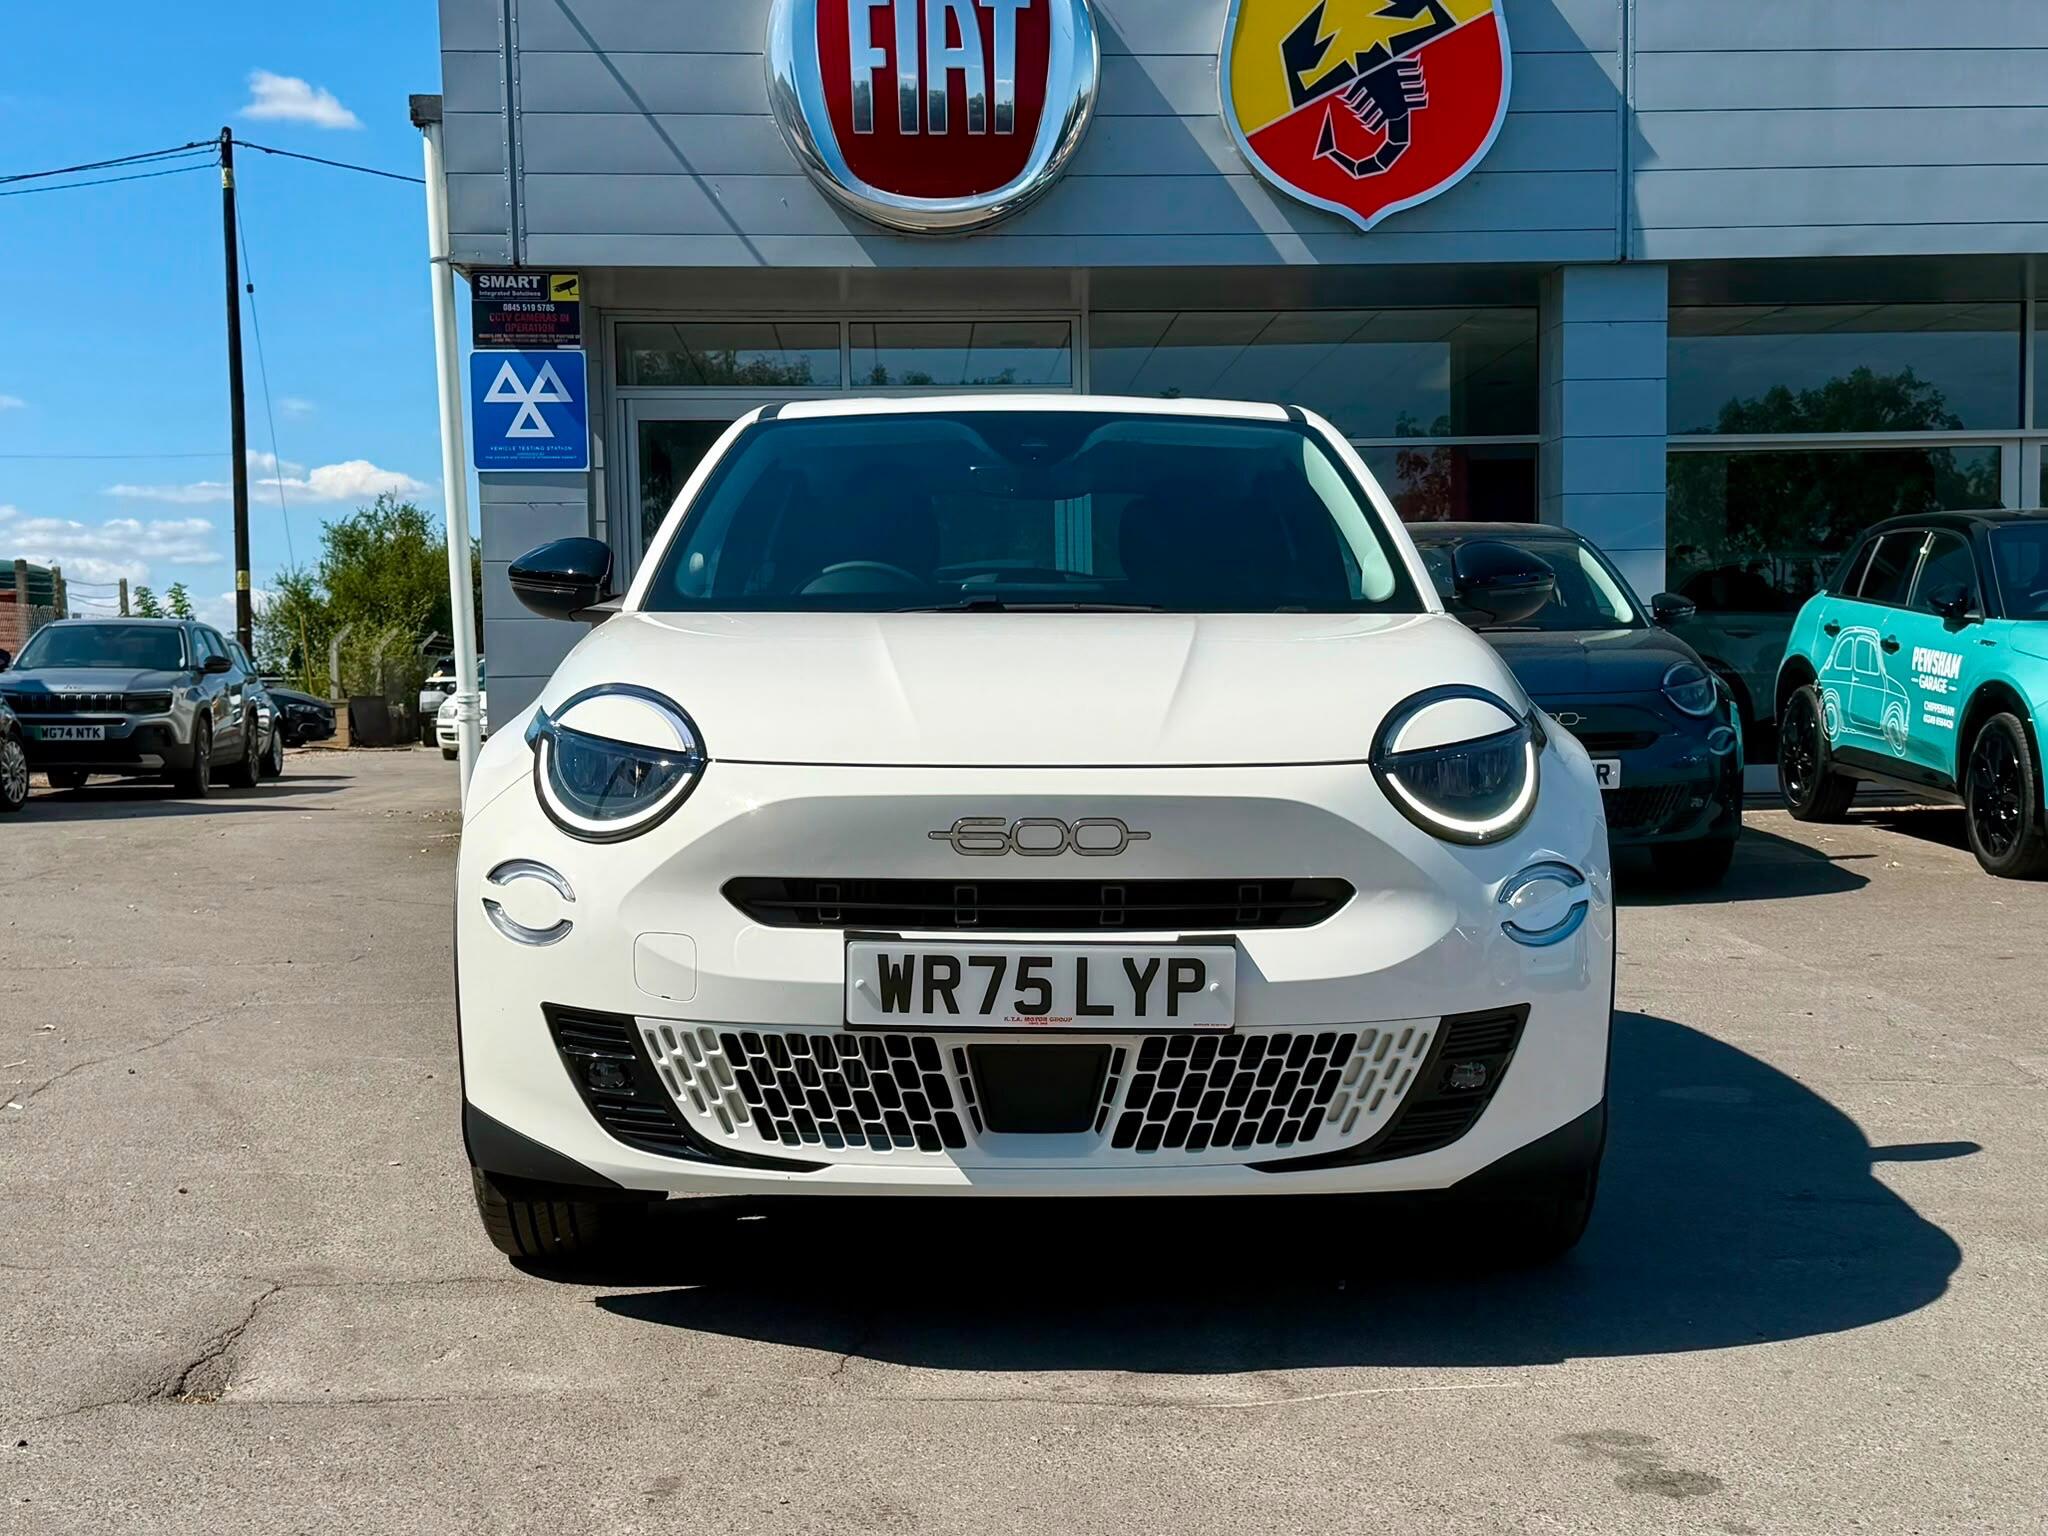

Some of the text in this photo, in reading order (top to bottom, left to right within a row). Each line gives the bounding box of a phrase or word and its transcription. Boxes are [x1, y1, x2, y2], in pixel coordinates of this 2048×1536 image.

[847, 0, 1030, 135] FIAT
[479, 275, 541, 288] SMART
[1911, 646, 1963, 679] PEWSHAM
[1919, 674, 1949, 694] GARAGE
[41, 727, 101, 739] WG74 NTK
[949, 817, 1131, 857] 600
[877, 953, 1206, 1018] WR75 LYP
